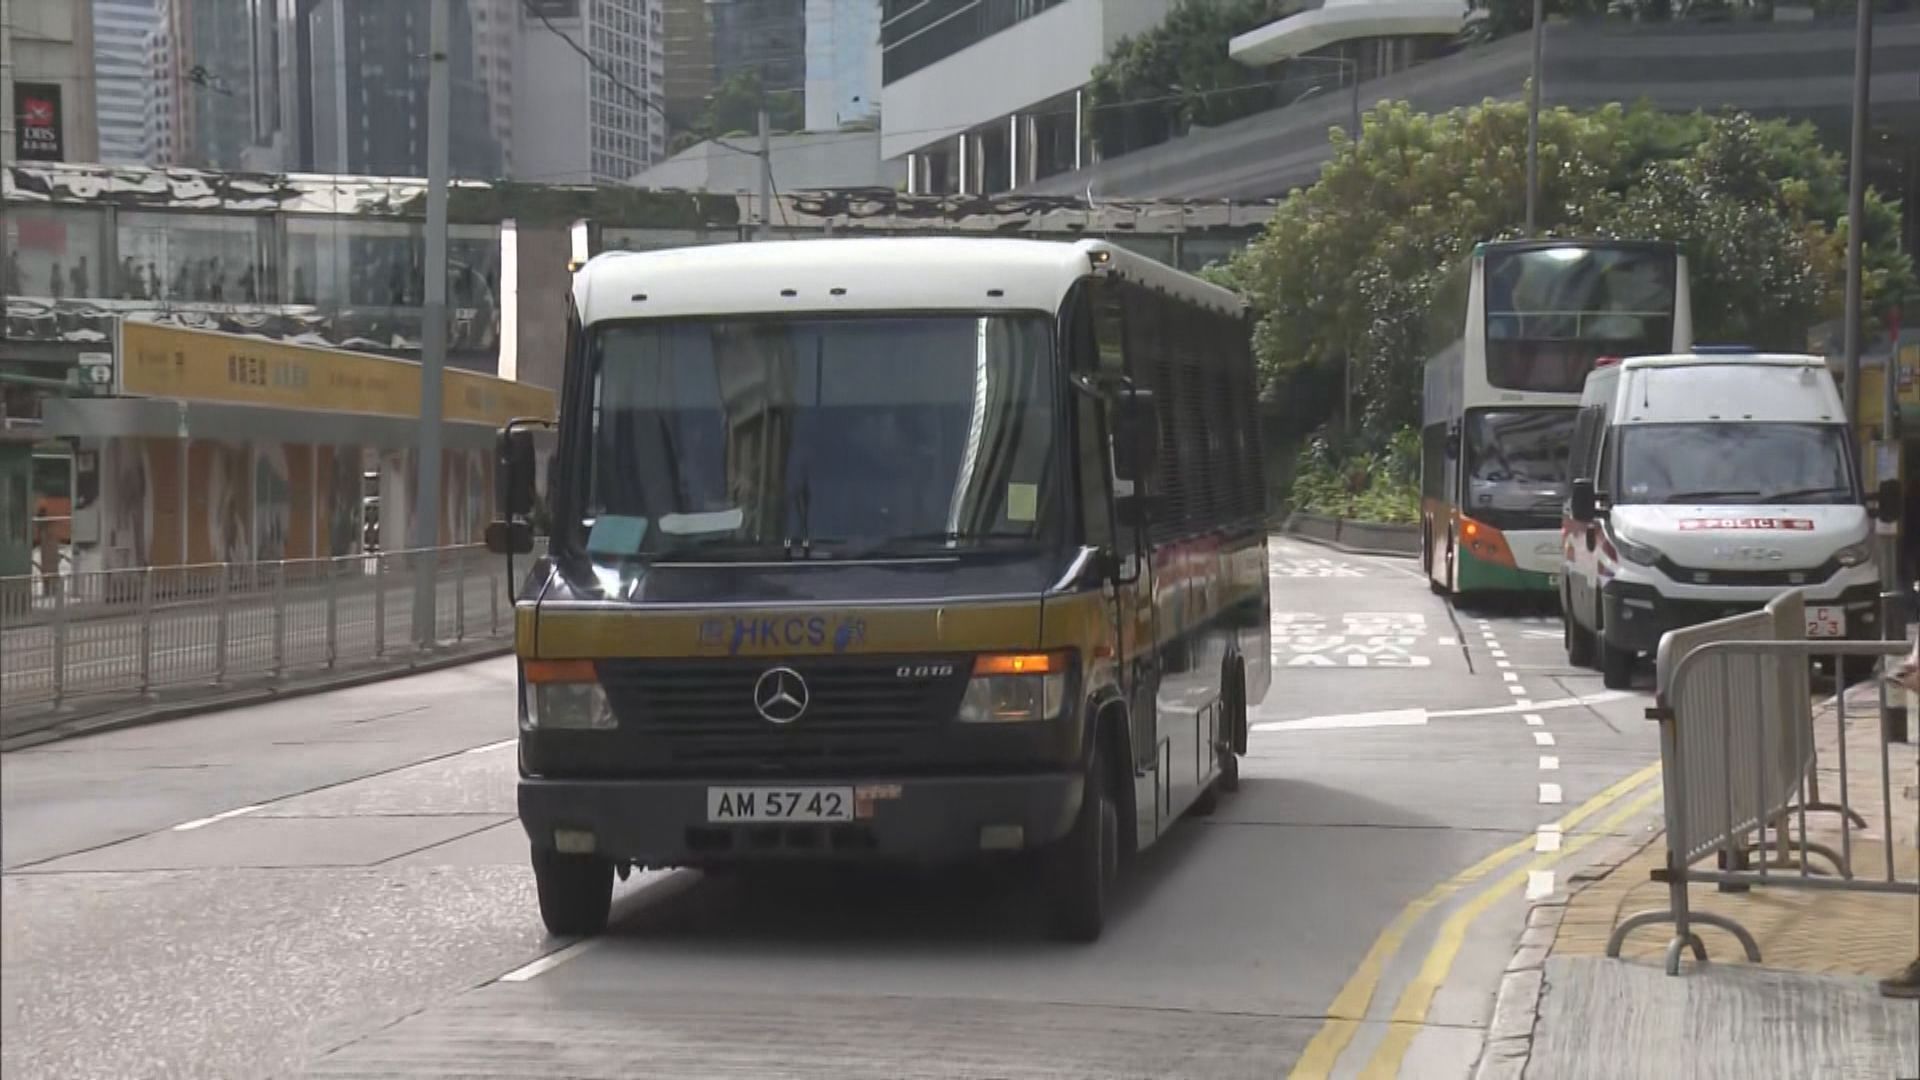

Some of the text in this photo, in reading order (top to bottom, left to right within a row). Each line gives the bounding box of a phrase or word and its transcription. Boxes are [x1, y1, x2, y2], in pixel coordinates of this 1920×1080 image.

[1817, 608, 1829, 621] C
[736, 616, 826, 646] HKCS
[717, 792, 755, 817] AM
[765, 792, 842, 817] 5742
